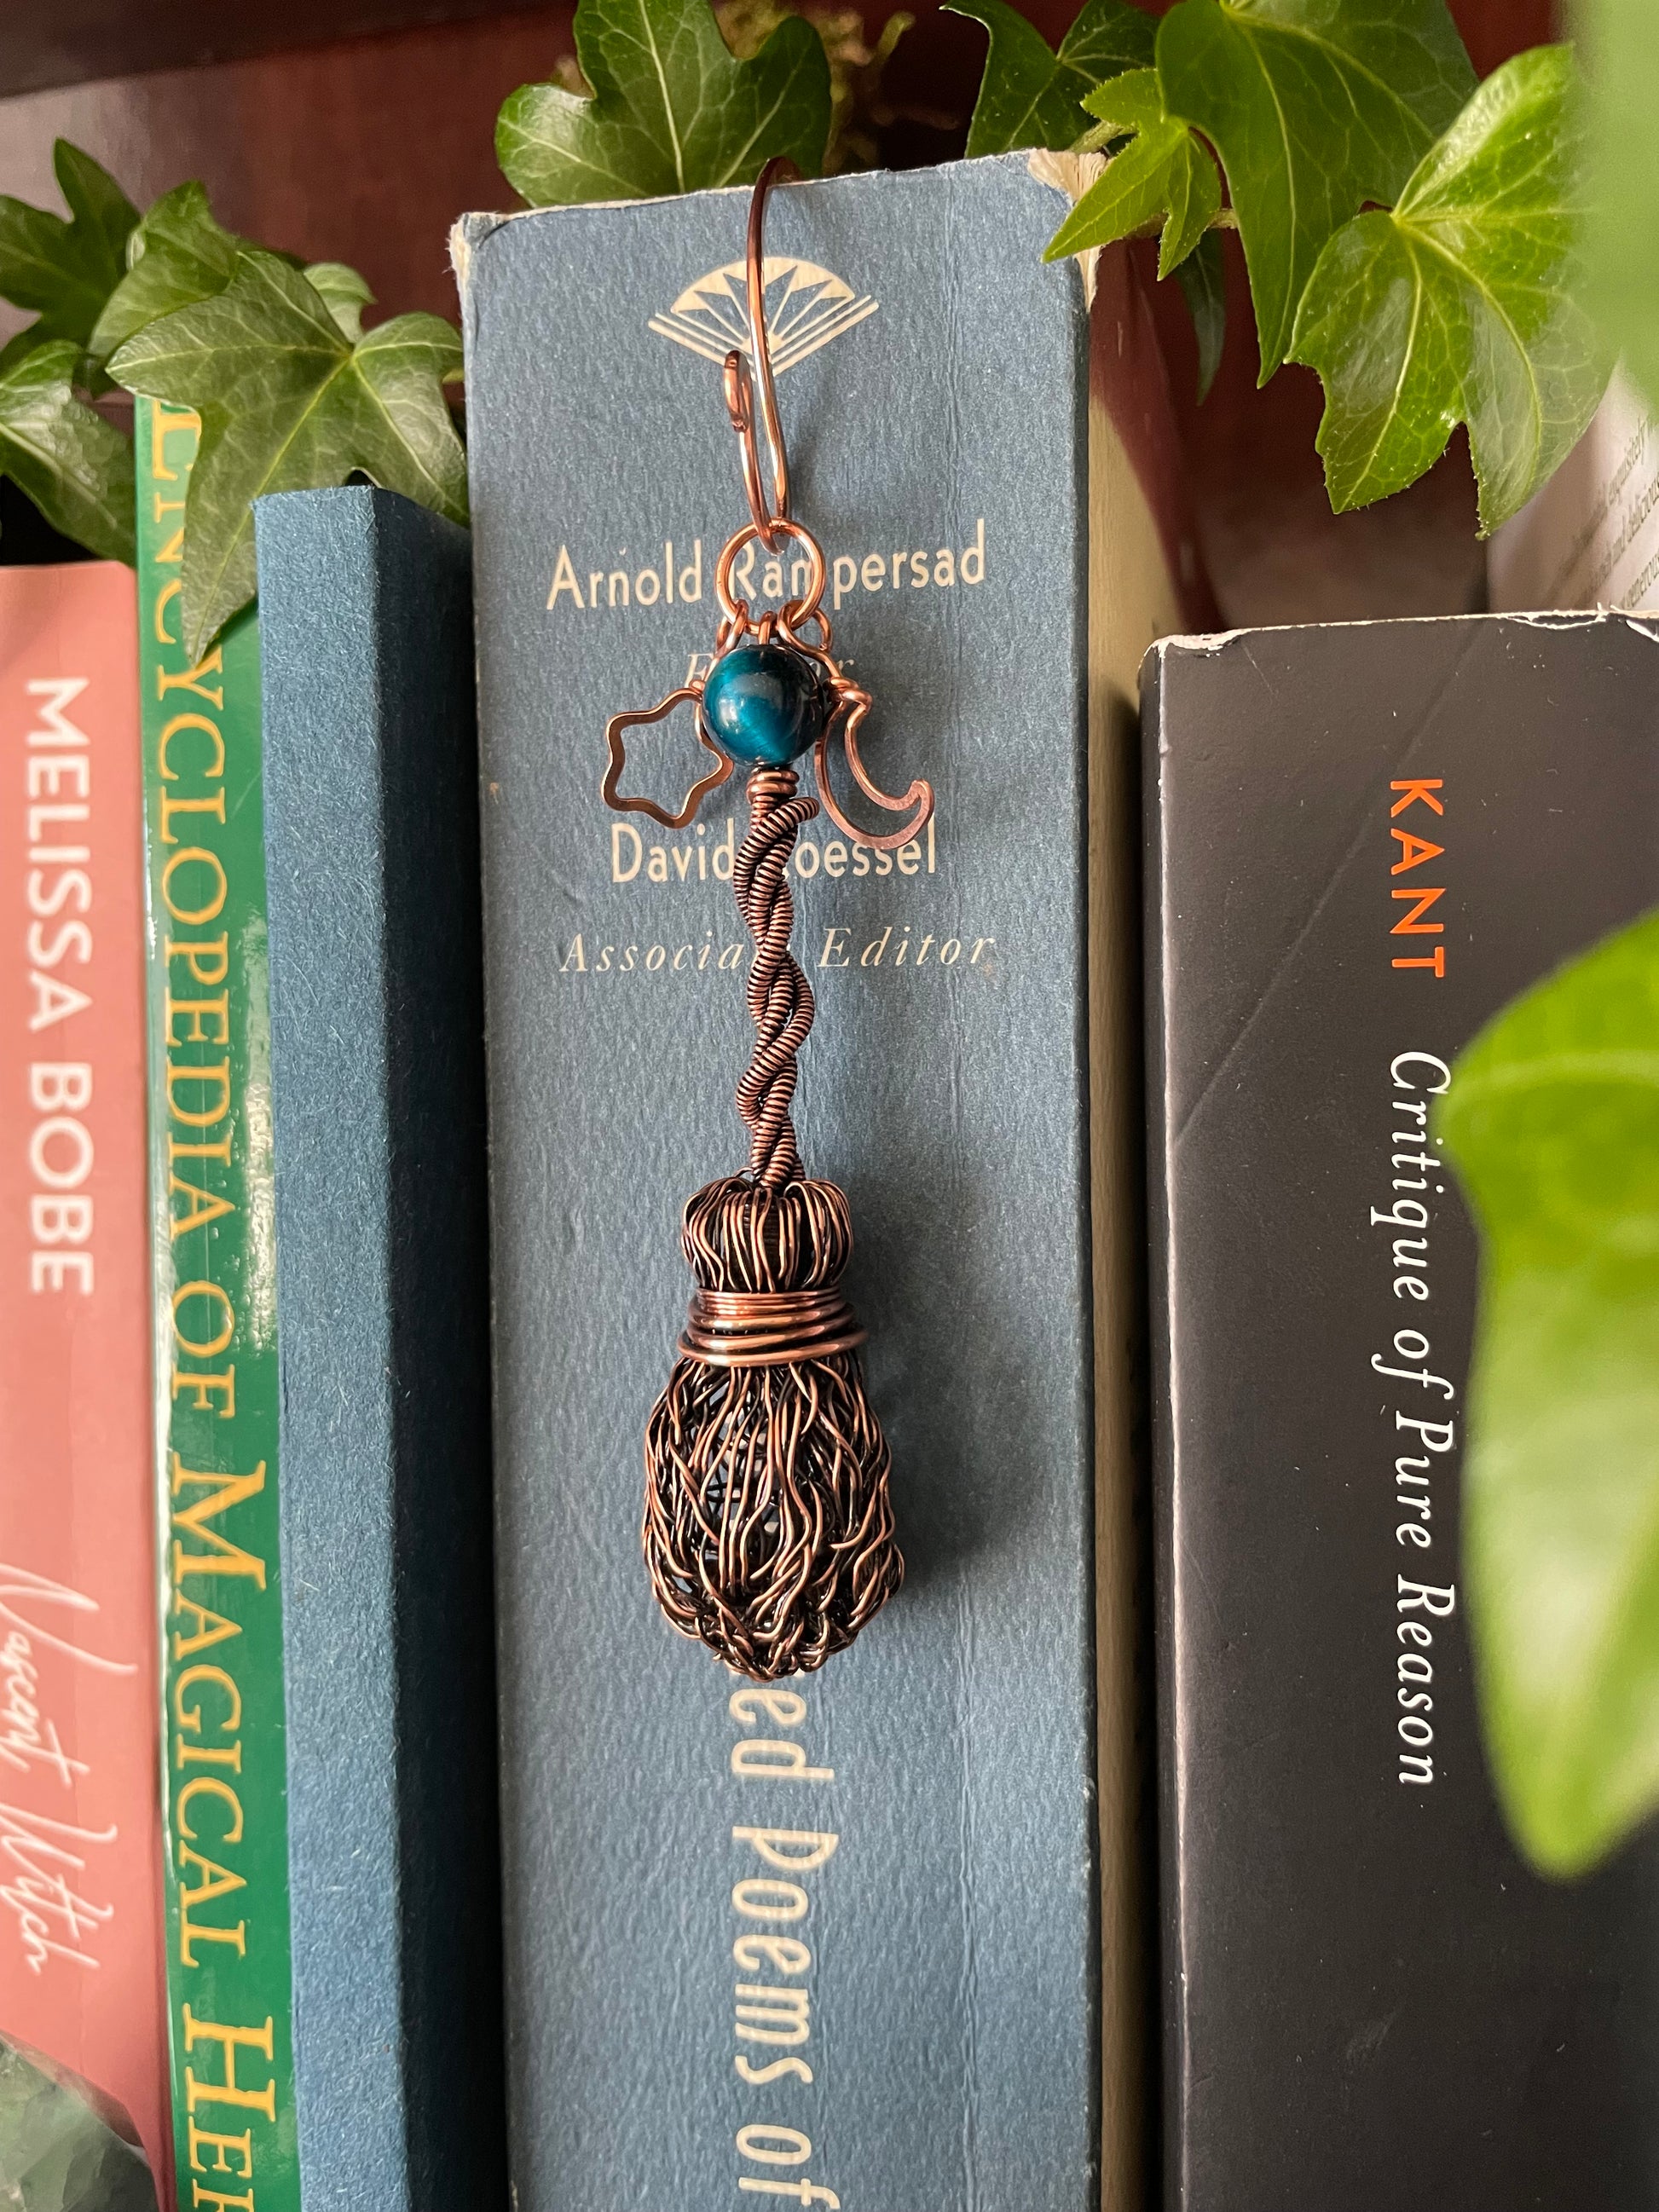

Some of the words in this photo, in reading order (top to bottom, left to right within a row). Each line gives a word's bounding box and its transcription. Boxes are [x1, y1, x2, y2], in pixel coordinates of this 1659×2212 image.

[546, 540, 702, 610] Arnold
[24, 677, 94, 1031] MELISSA
[611, 817, 735, 884] David
[781, 811, 936, 879] oessel
[1390, 778, 1447, 979] KANT
[559, 933, 791, 973] Associa
[817, 926, 996, 968] Editor
[28, 1061, 95, 1297] BOBE
[1370, 1050, 1452, 1302] Critique
[171, 1280, 235, 1418] OF
[1371, 1328, 1455, 1401] of
[1394, 1409, 1454, 1548] Pure
[173, 1451, 267, 1969] MAGICAL
[1396, 1573, 1456, 1786] Reason
[0, 1801, 118, 1977] Witch
[731, 1826, 840, 2086] Poems
[736, 2123, 842, 2210] of
